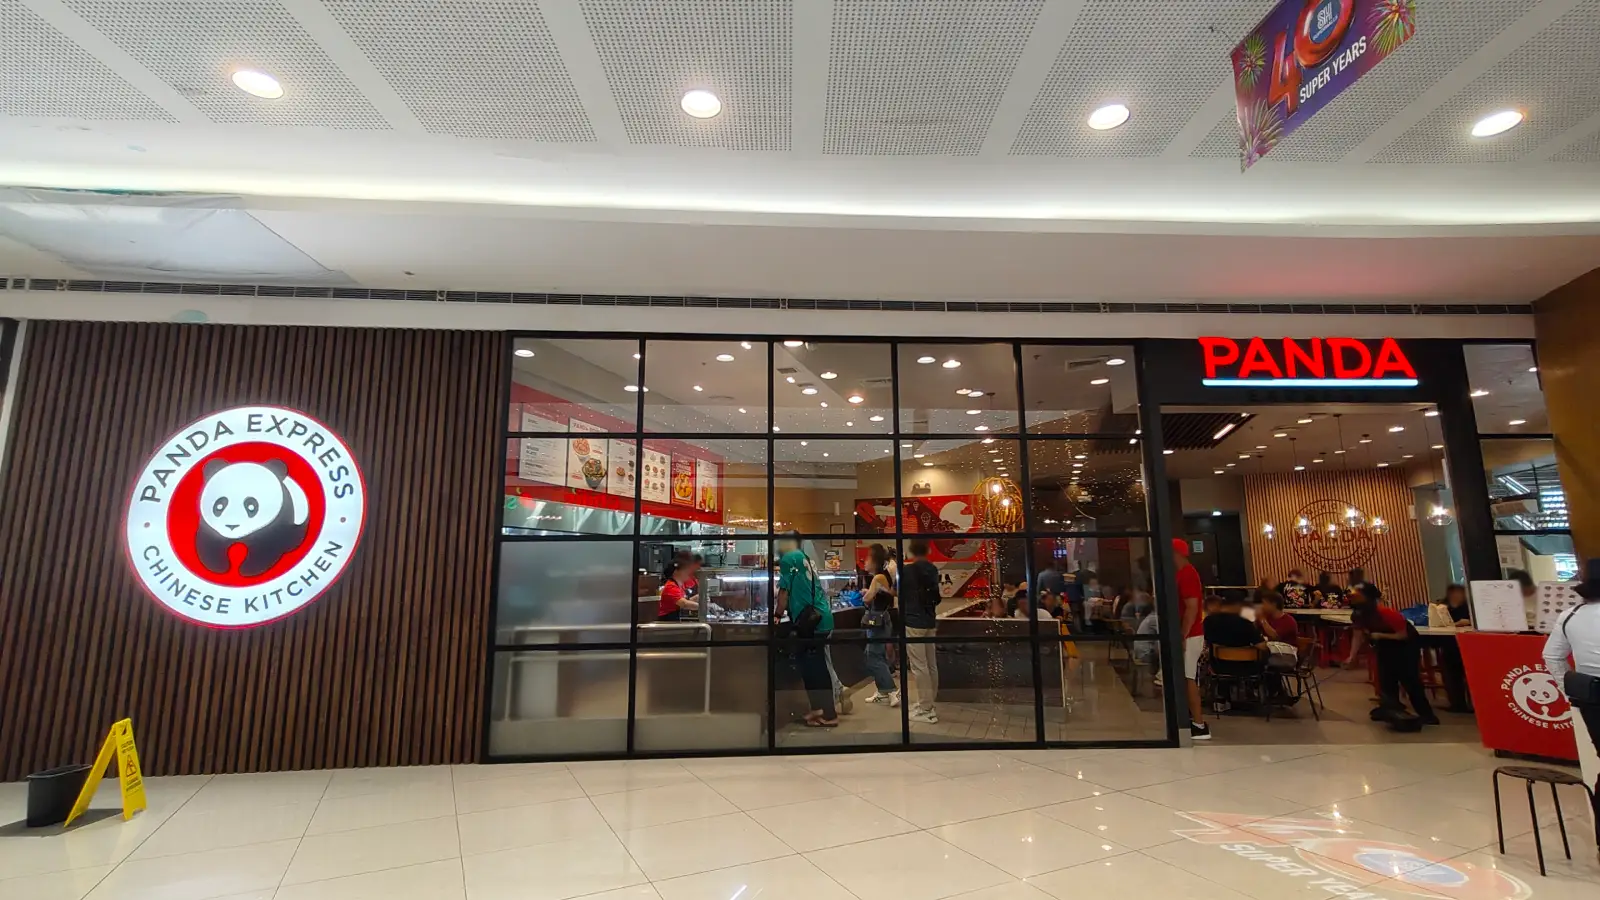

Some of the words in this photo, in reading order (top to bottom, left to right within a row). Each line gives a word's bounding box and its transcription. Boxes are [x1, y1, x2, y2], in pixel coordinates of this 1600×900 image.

[1300, 67, 1330, 103] SUPER
[1332, 36, 1367, 75] YEARS
[1198, 336, 1418, 379] PANDA
[140, 420, 234, 502] PANDA
[247, 413, 354, 499] EXPRESS
[143, 545, 231, 613] CHINESE
[244, 540, 343, 613] KITCHEN
[1501, 664, 1532, 690] PANDA
[1508, 702, 1549, 728] CHINESE
[1219, 843, 1319, 877] SUPER
[1308, 877, 1387, 900] YEA
